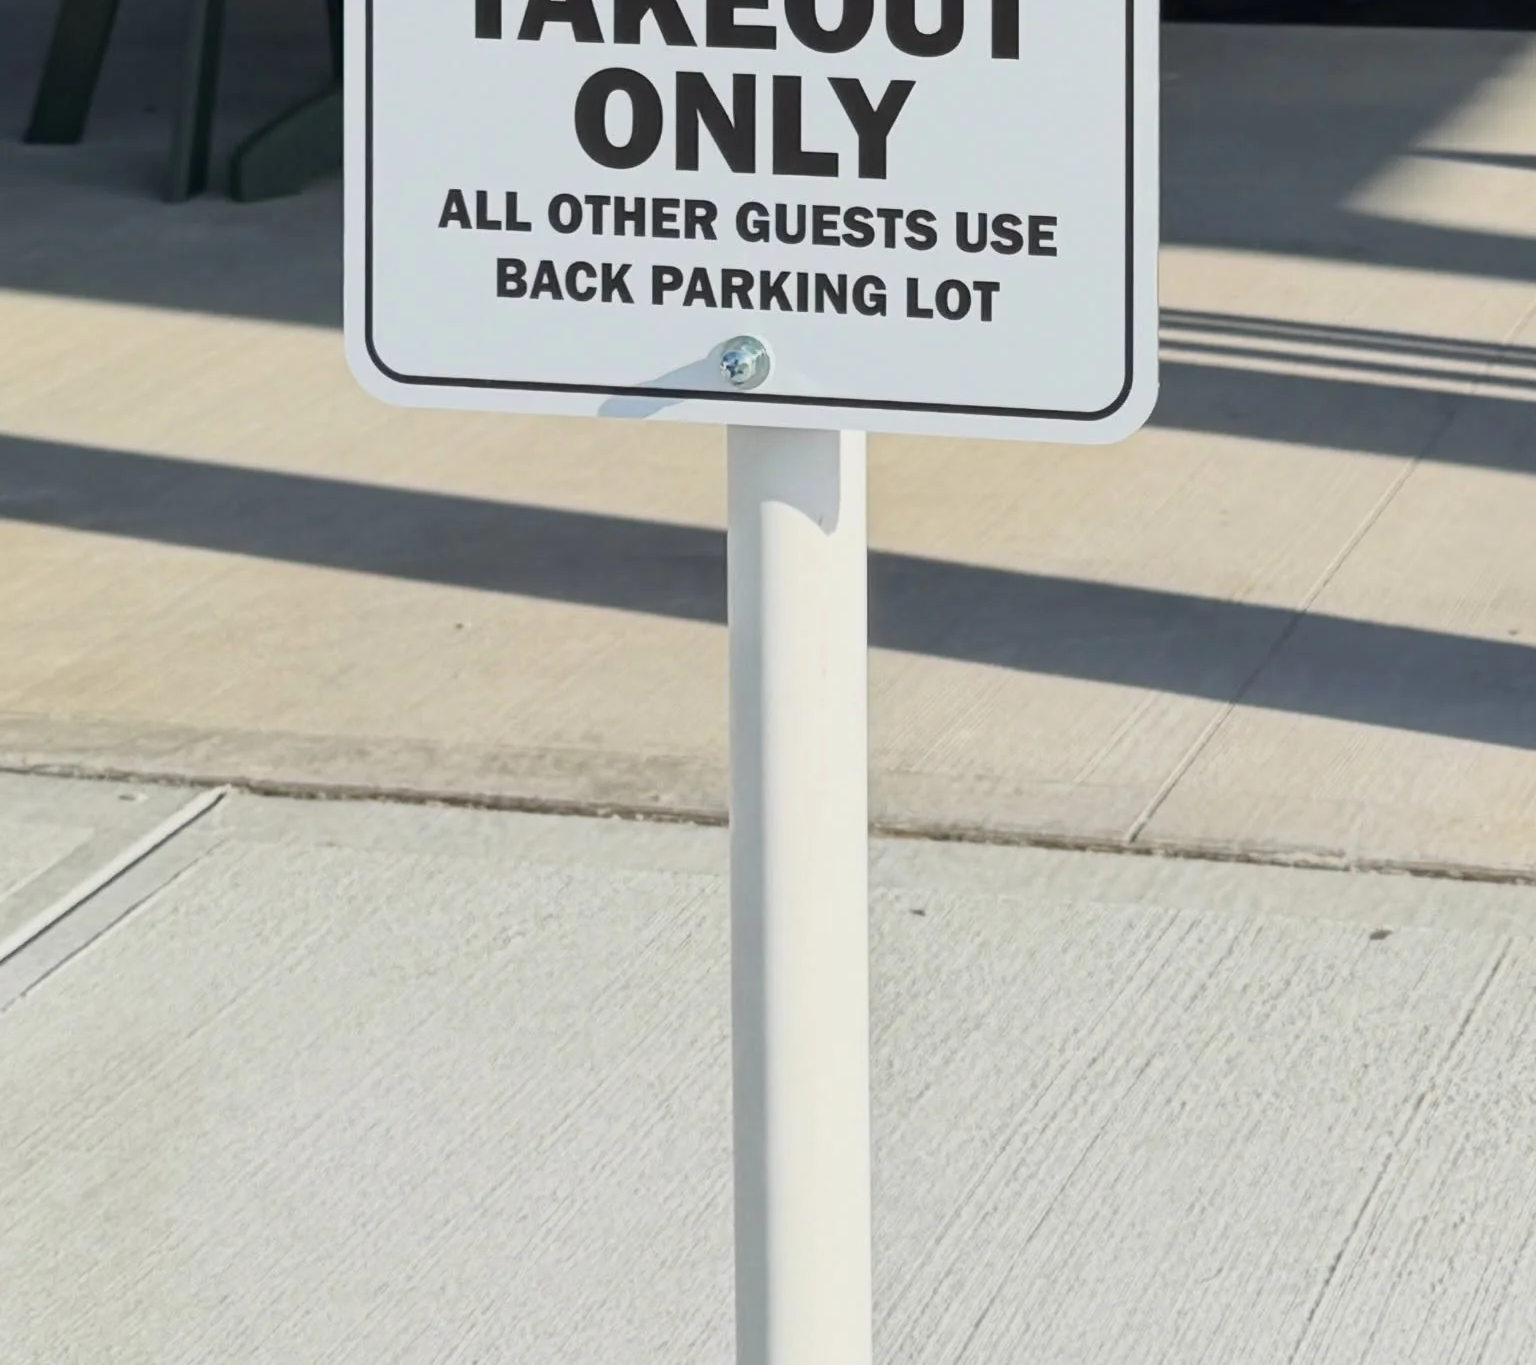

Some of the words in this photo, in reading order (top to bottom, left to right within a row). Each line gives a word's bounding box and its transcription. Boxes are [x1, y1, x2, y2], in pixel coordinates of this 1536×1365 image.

[573, 66, 916, 180] ONLY
[437, 188, 533, 234] ALL
[548, 193, 718, 241] OTHER
[735, 201, 938, 251] GUESTS
[955, 209, 1059, 258] USE
[495, 258, 634, 306] BACK
[652, 264, 887, 318] PARKING
[906, 276, 1001, 323] LOT
